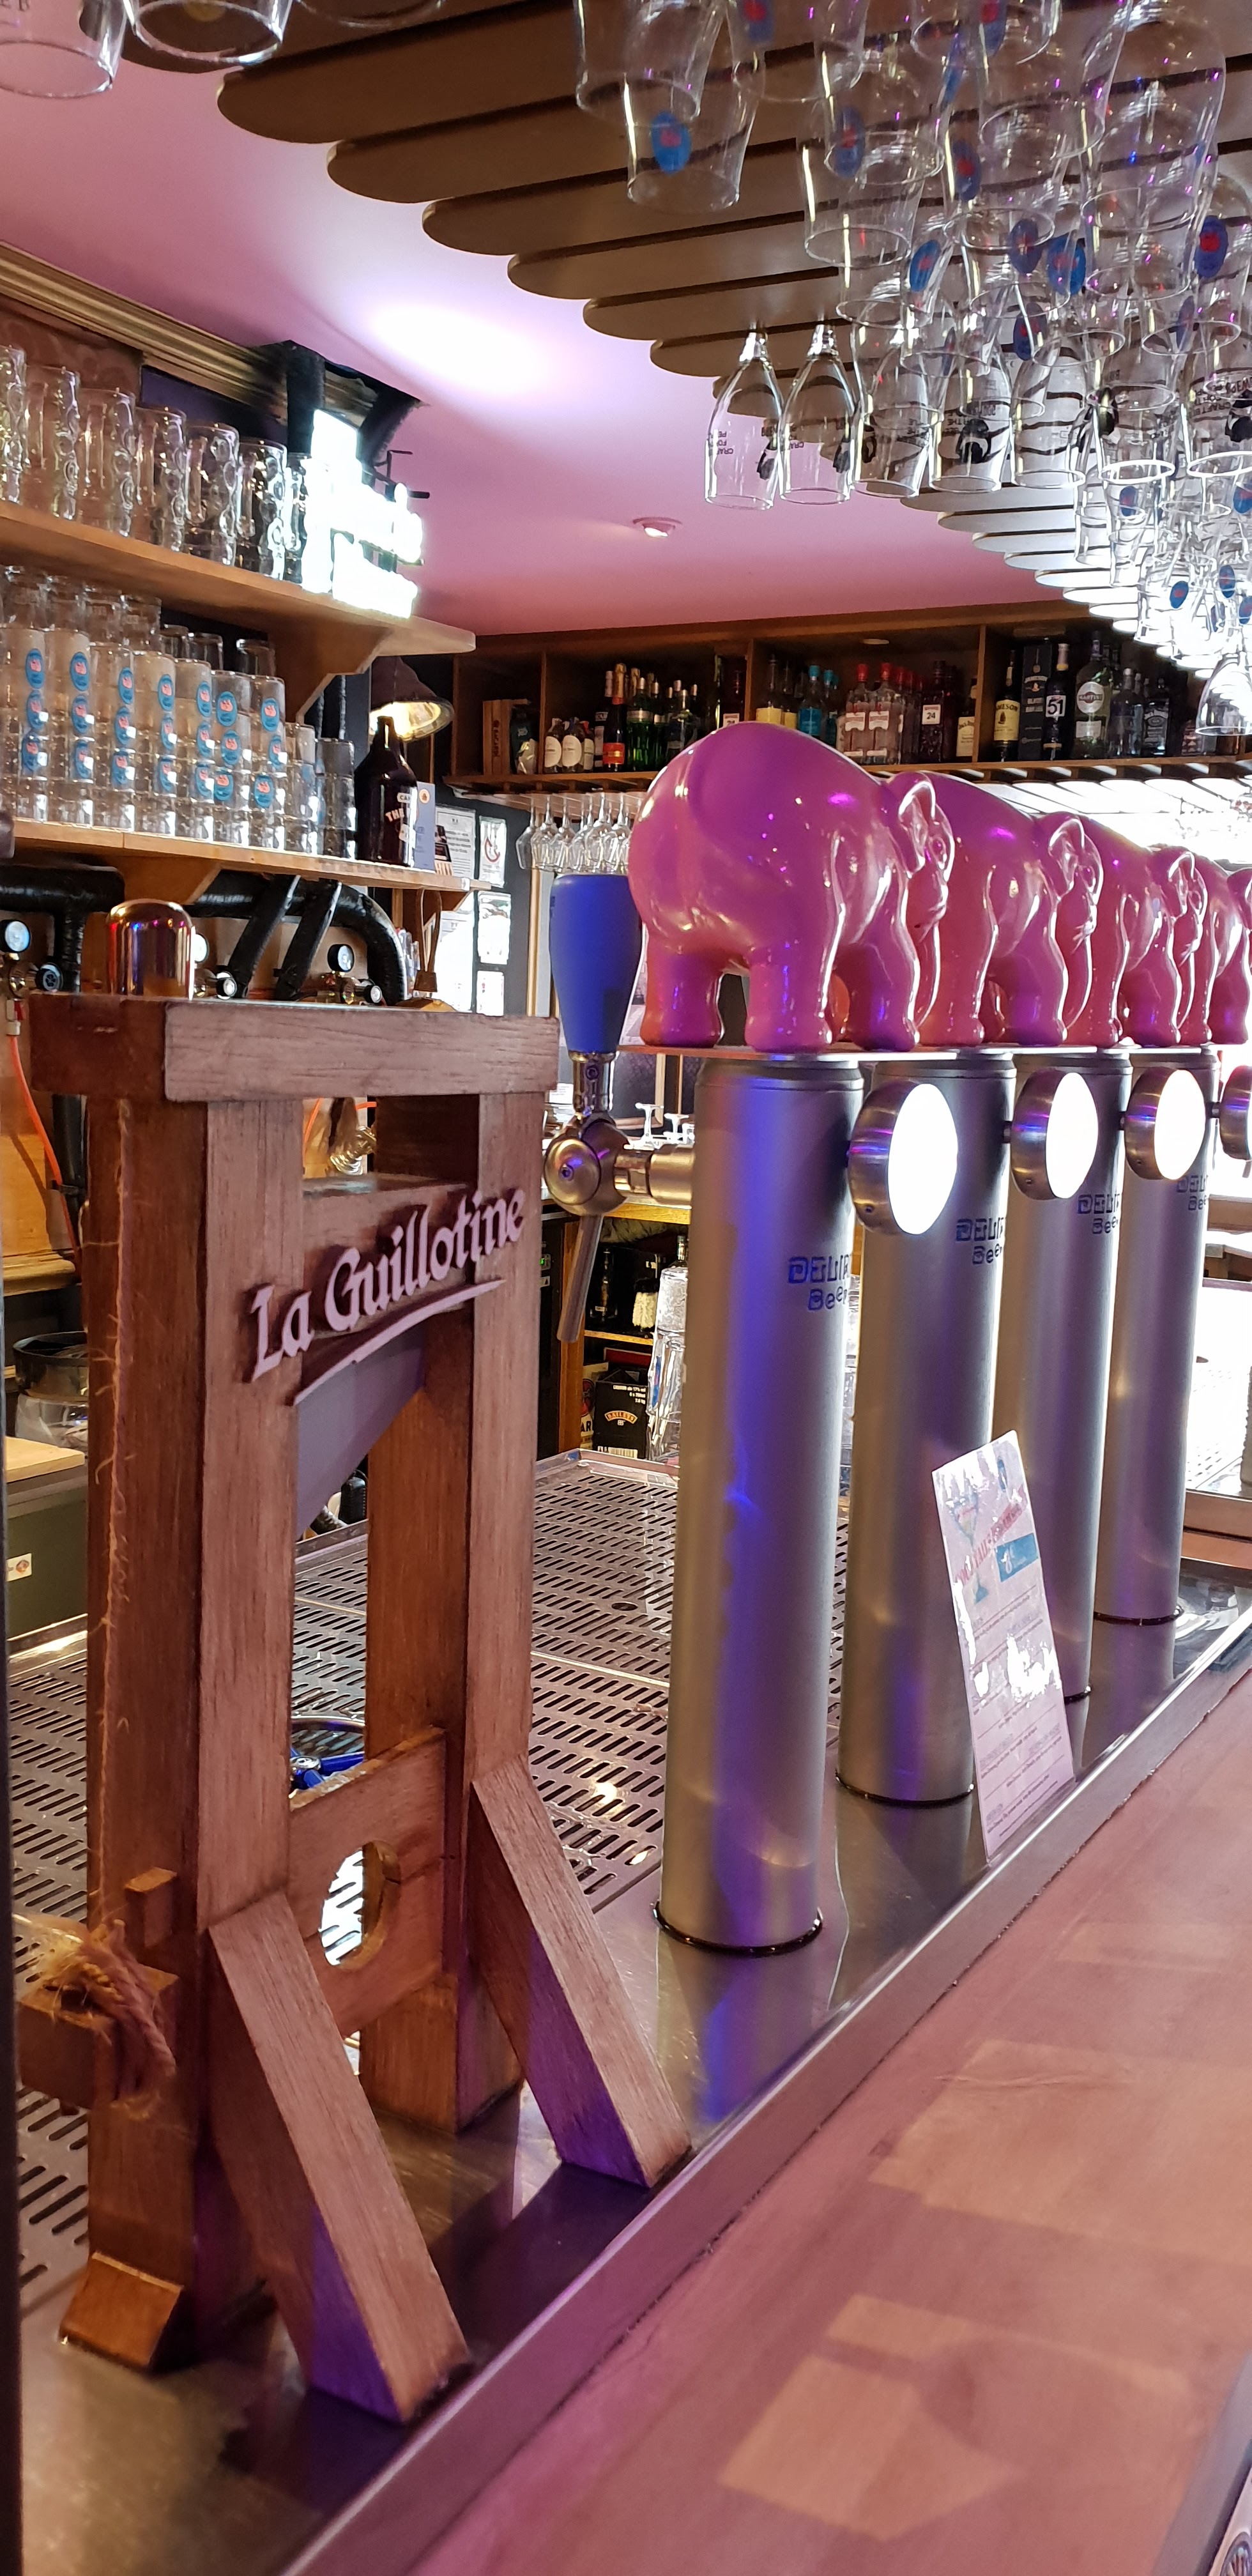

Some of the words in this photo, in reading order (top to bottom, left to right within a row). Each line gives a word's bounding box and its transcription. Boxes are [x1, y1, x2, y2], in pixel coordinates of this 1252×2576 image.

[1047, 698, 1064, 716] 51
[926, 712, 936, 720] 24
[385, 808, 405, 822] THE
[251, 1284, 315, 1383] La
[324, 1189, 526, 1331] Guillotine
[607, 1411, 635, 1422] BAILEYS
